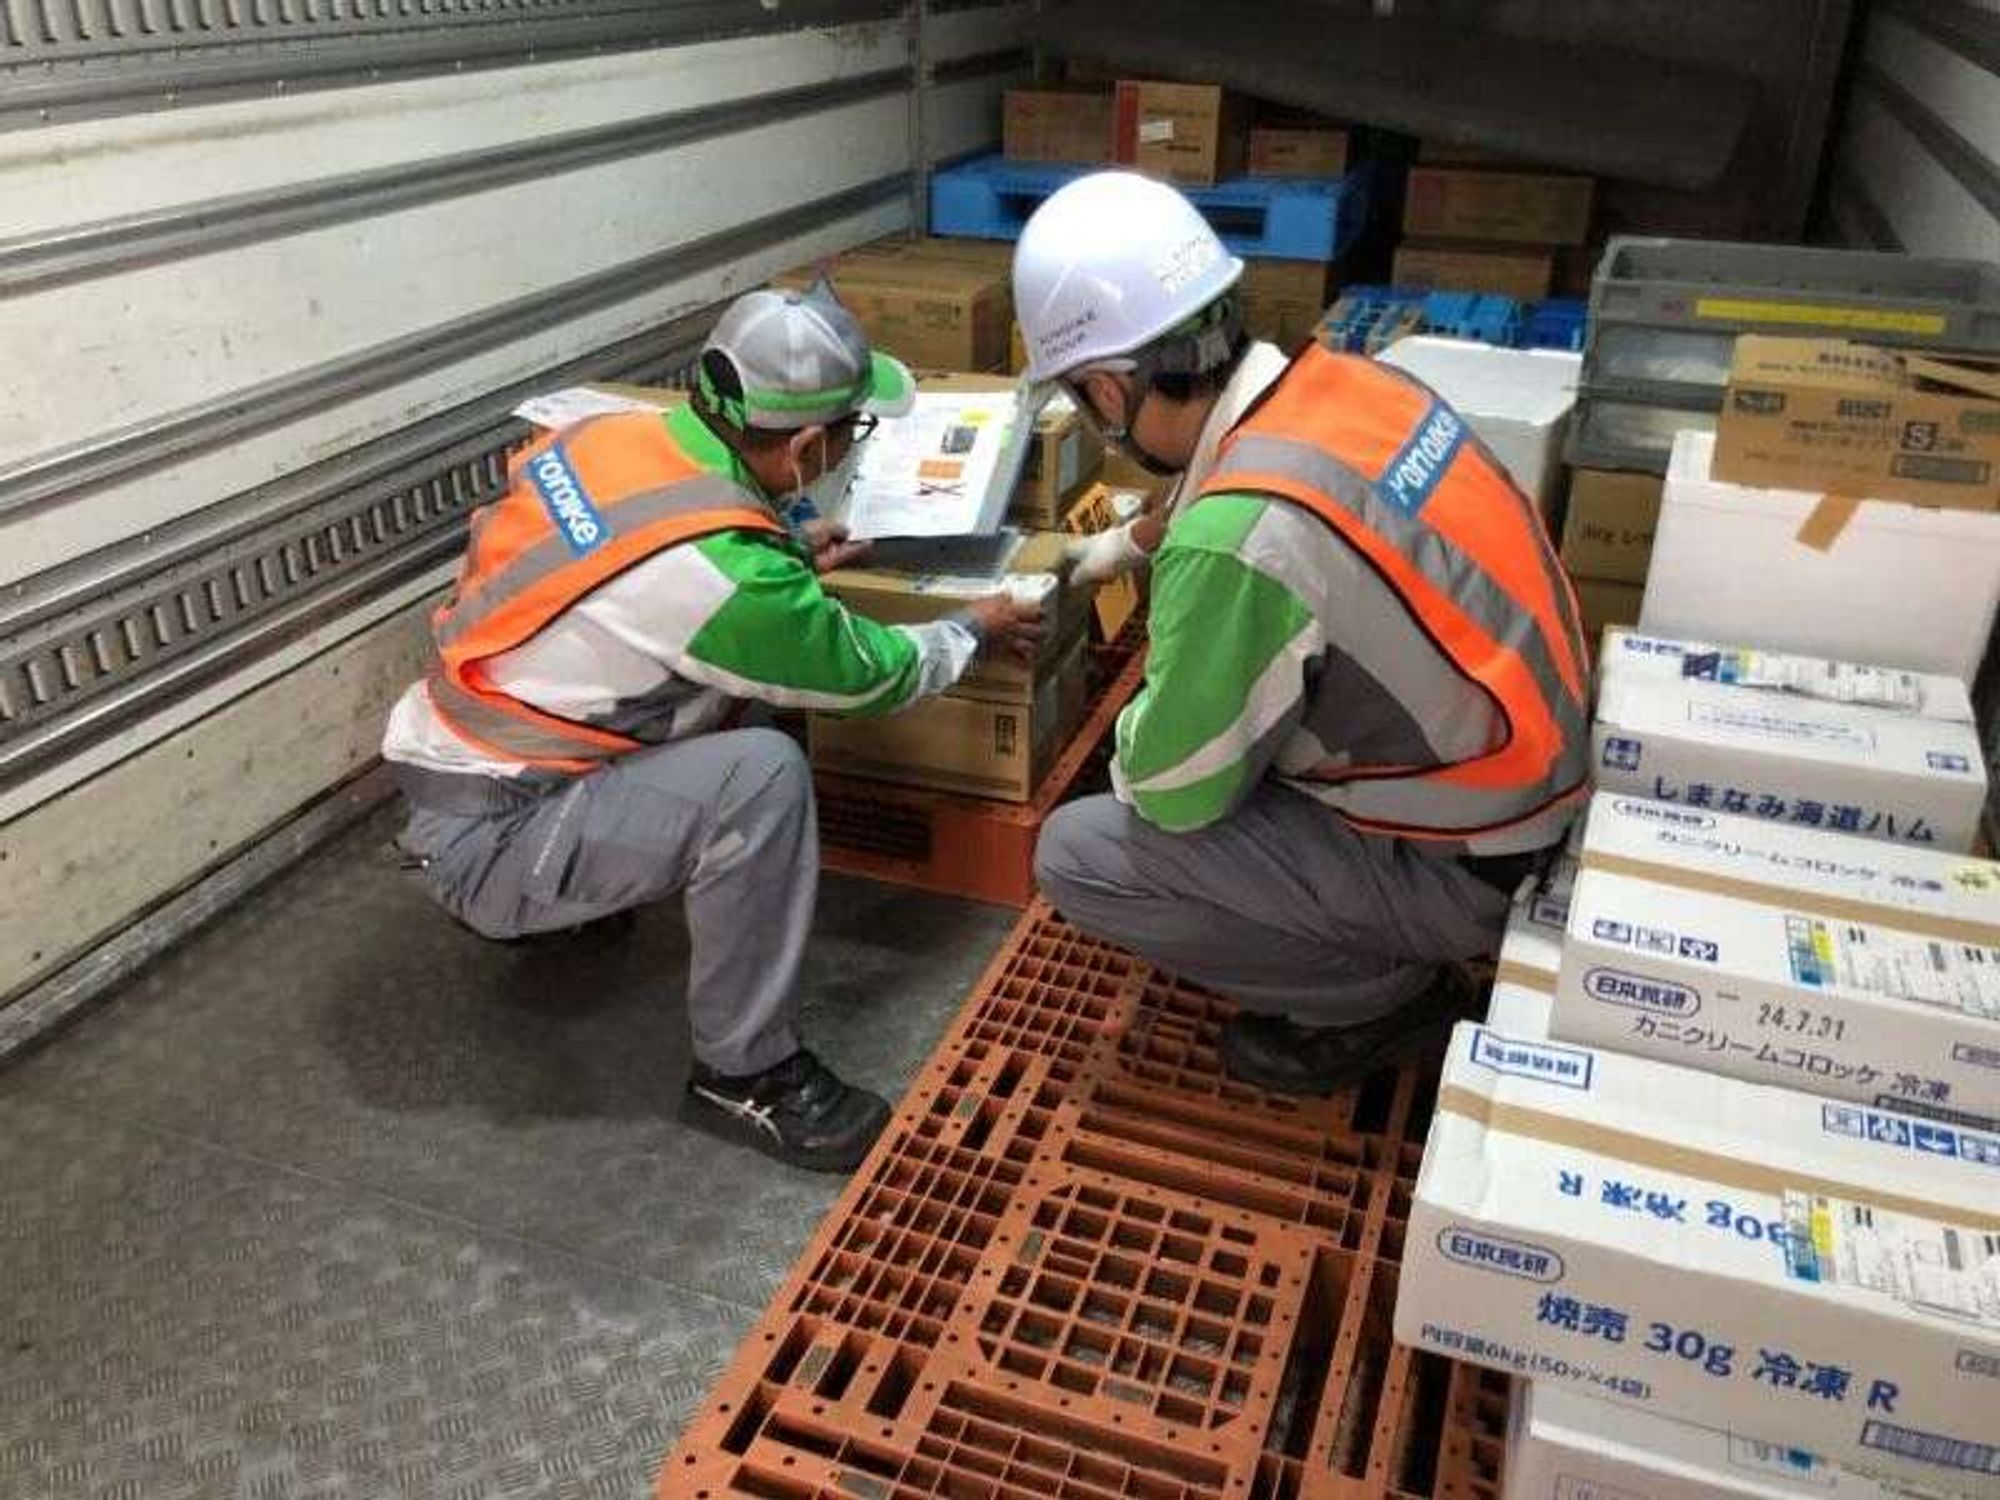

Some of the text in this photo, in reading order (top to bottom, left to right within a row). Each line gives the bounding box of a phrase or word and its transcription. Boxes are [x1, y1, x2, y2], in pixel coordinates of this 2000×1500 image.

[1654, 775, 1936, 841] しまなみ海道ハム
[1757, 1002, 1845, 1041] 24.7.31
[1631, 1014, 1882, 1085] カニクリームコロッケ
[1889, 1071, 1952, 1101] 冷凍
[1558, 1169, 1584, 1197] R
[1536, 1290, 1899, 1412] 焼売 30g 冷凍 R
